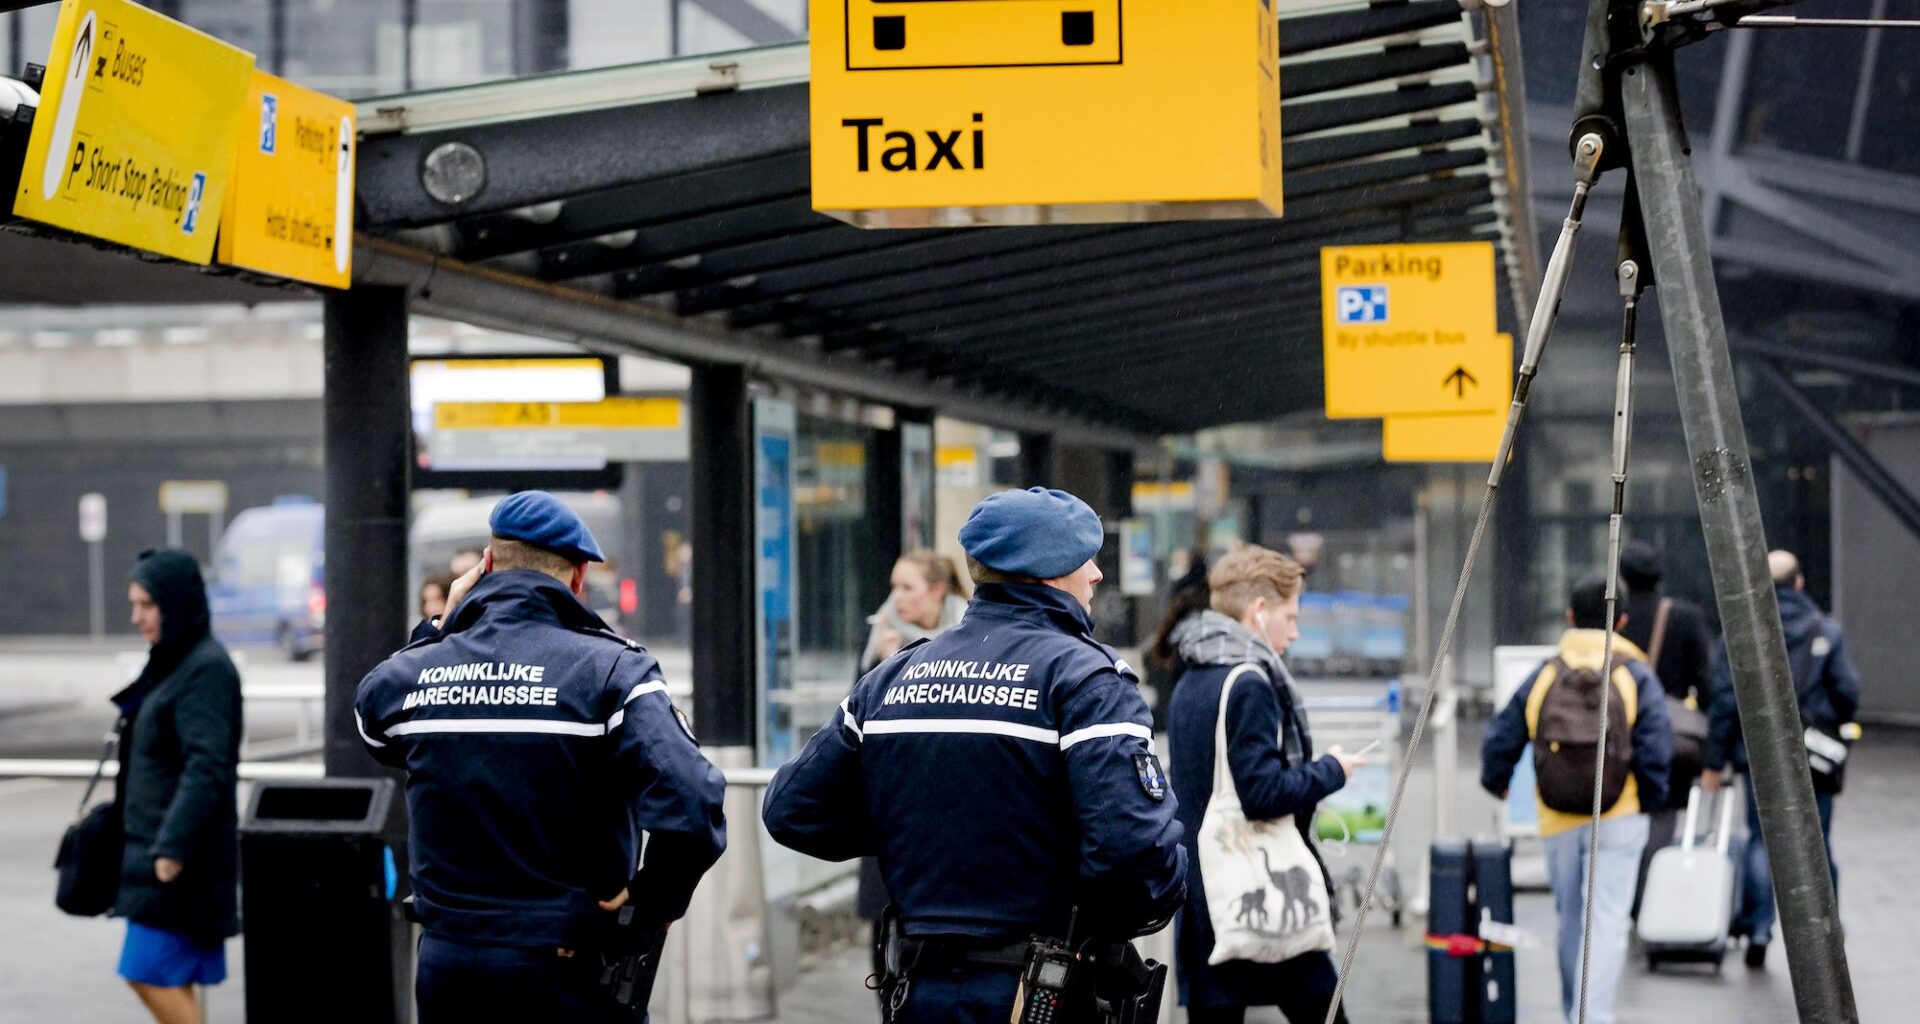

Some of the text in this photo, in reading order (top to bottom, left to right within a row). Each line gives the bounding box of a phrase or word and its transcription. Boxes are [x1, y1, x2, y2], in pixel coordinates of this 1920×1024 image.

[112, 37, 147, 87] Buses
[841, 112, 985, 173] Taxi
[85, 145, 121, 194] Short
[120, 158, 147, 213] Stop
[146, 166, 187, 225] Parking
[1335, 253, 1442, 282] Parking
[1336, 329, 1467, 351] By shuttle bus
[417, 662, 546, 685] KONINKLIJKE
[903, 660, 1029, 682] KONINKLIJKE
[402, 686, 559, 711] MARECHAUSSEE
[882, 684, 1040, 711] MARECHAUSSEE
